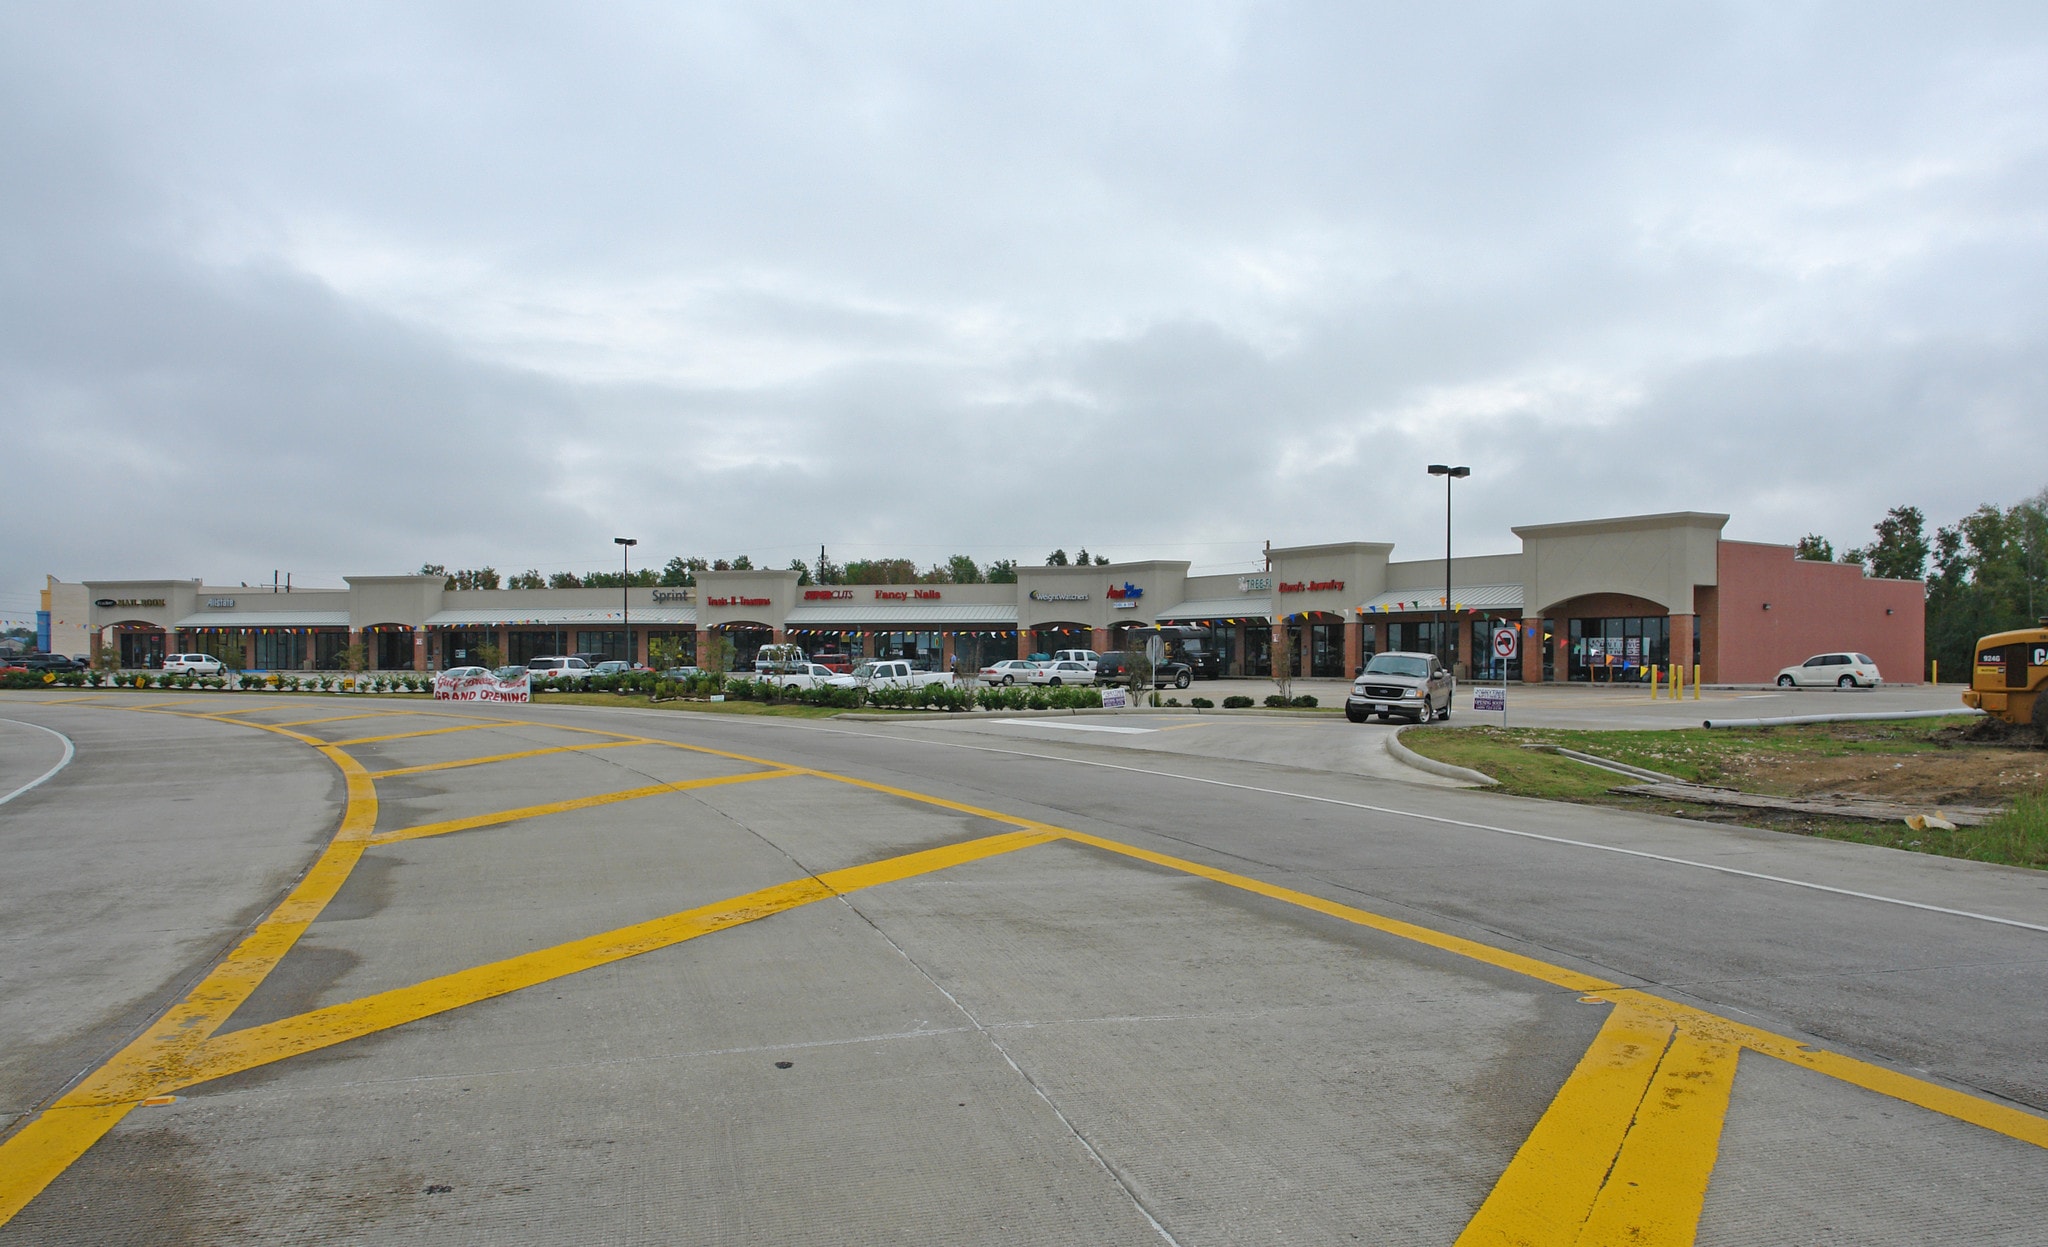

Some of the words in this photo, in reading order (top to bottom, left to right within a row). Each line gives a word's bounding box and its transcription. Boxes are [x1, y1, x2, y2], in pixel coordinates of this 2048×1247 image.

[652, 589, 688, 604] Sprint
[804, 590, 853, 600] SUPERCUTS
[875, 589, 907, 601] Fancy
[913, 589, 941, 600] Nails
[207, 598, 235, 608] Allstate
[435, 690, 477, 701] GRAND
[480, 689, 528, 702] OPENING
